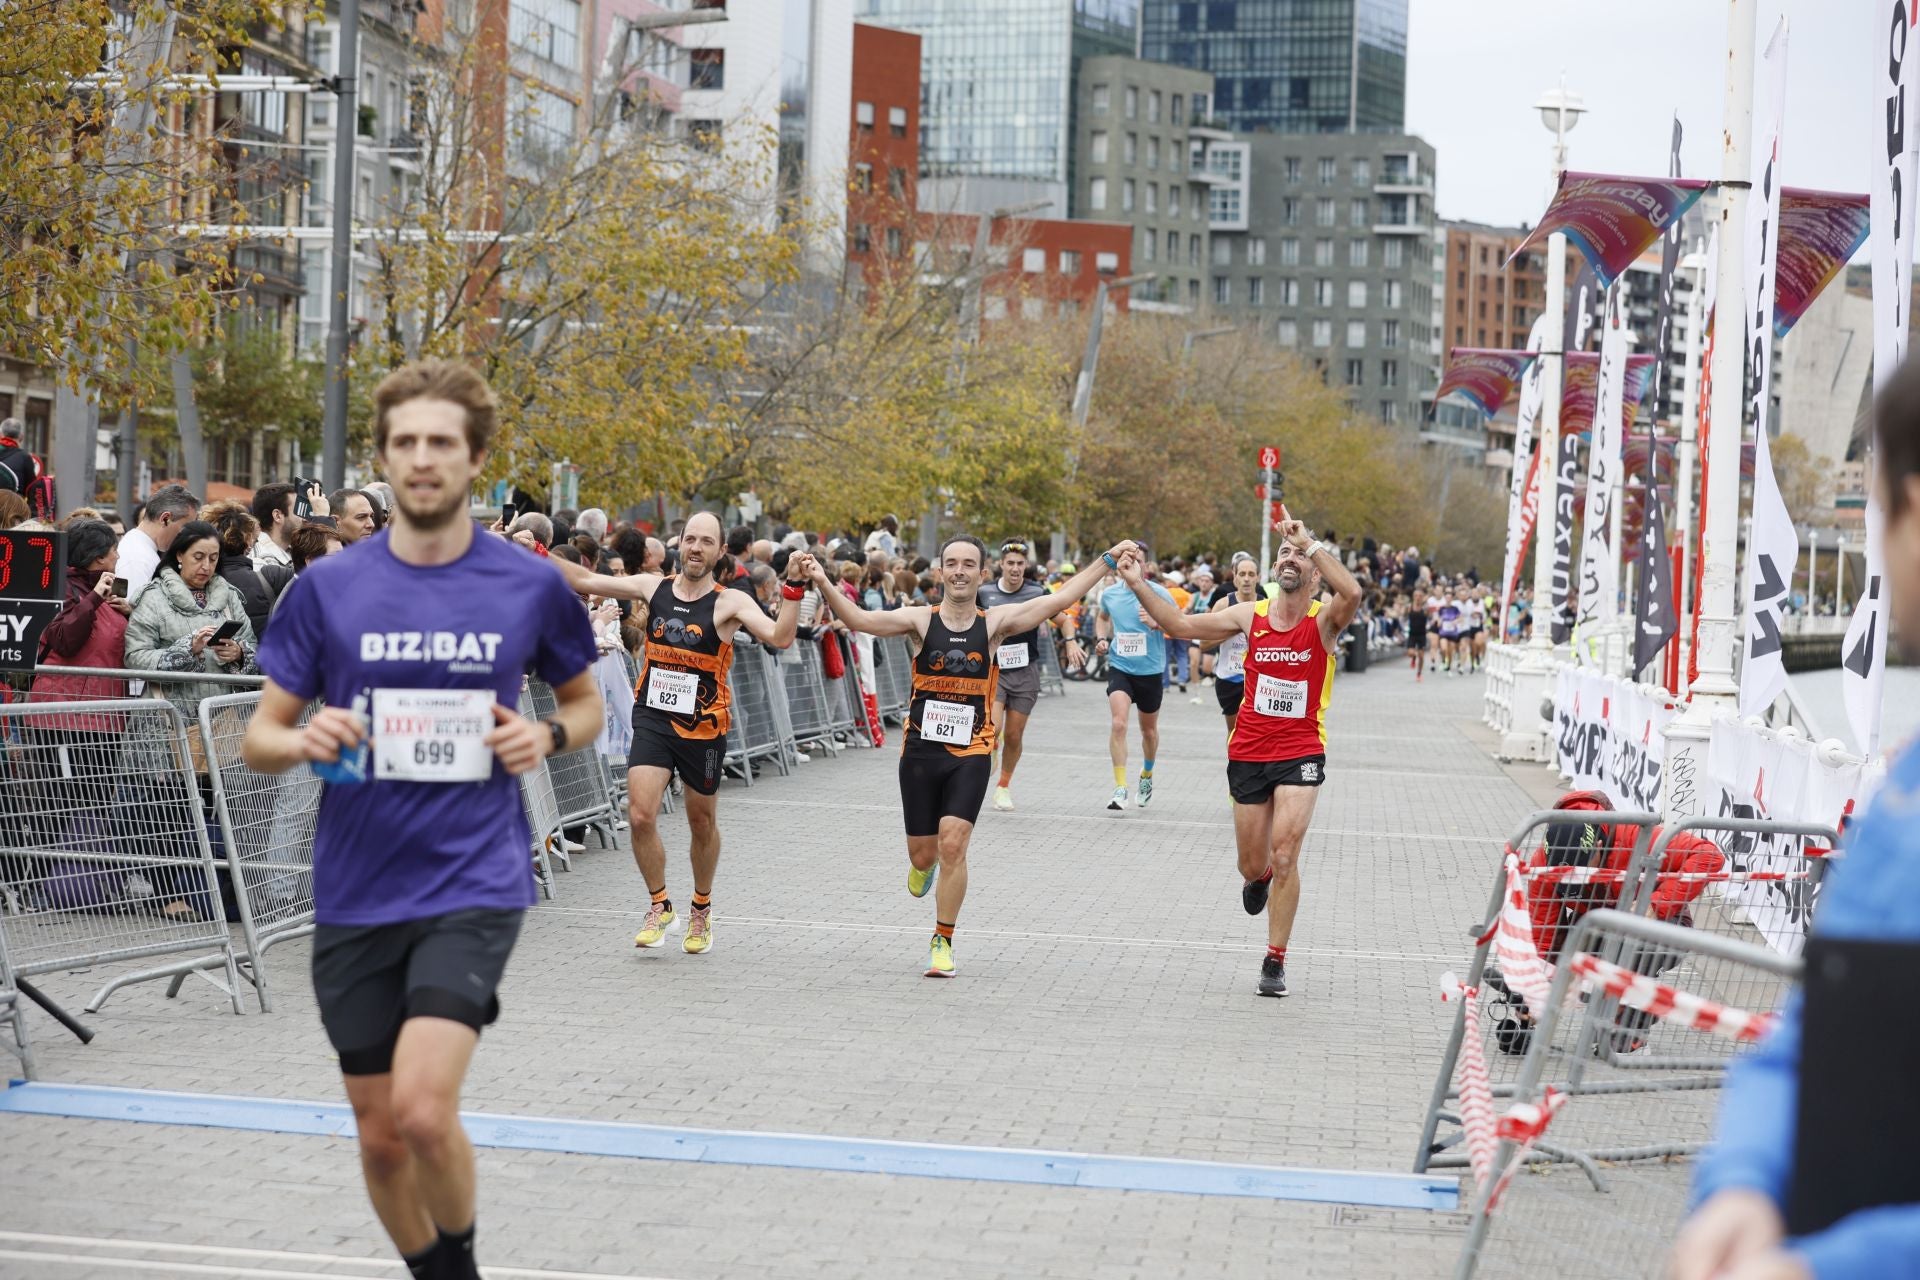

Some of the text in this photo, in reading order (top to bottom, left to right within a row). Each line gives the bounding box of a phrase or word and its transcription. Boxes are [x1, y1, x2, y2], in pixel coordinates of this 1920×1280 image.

[1123, 645, 1138, 653] 2277
[1006, 656, 1022, 665] 2273
[1254, 651, 1299, 662] OZONO
[661, 673, 686, 682] CORREO
[652, 680, 669, 691] XXXVI
[1273, 680, 1298, 689] CORREO
[669, 687, 692, 695] BILBAO
[1259, 685, 1280, 698] XXXVI
[659, 691, 678, 706] 623
[939, 704, 964, 713] CORREO
[1267, 698, 1293, 712] 1898
[926, 712, 947, 723] XXXVI
[947, 718, 969, 726] BILBAO
[936, 723, 955, 737] 621
[414, 739, 456, 765] 699
